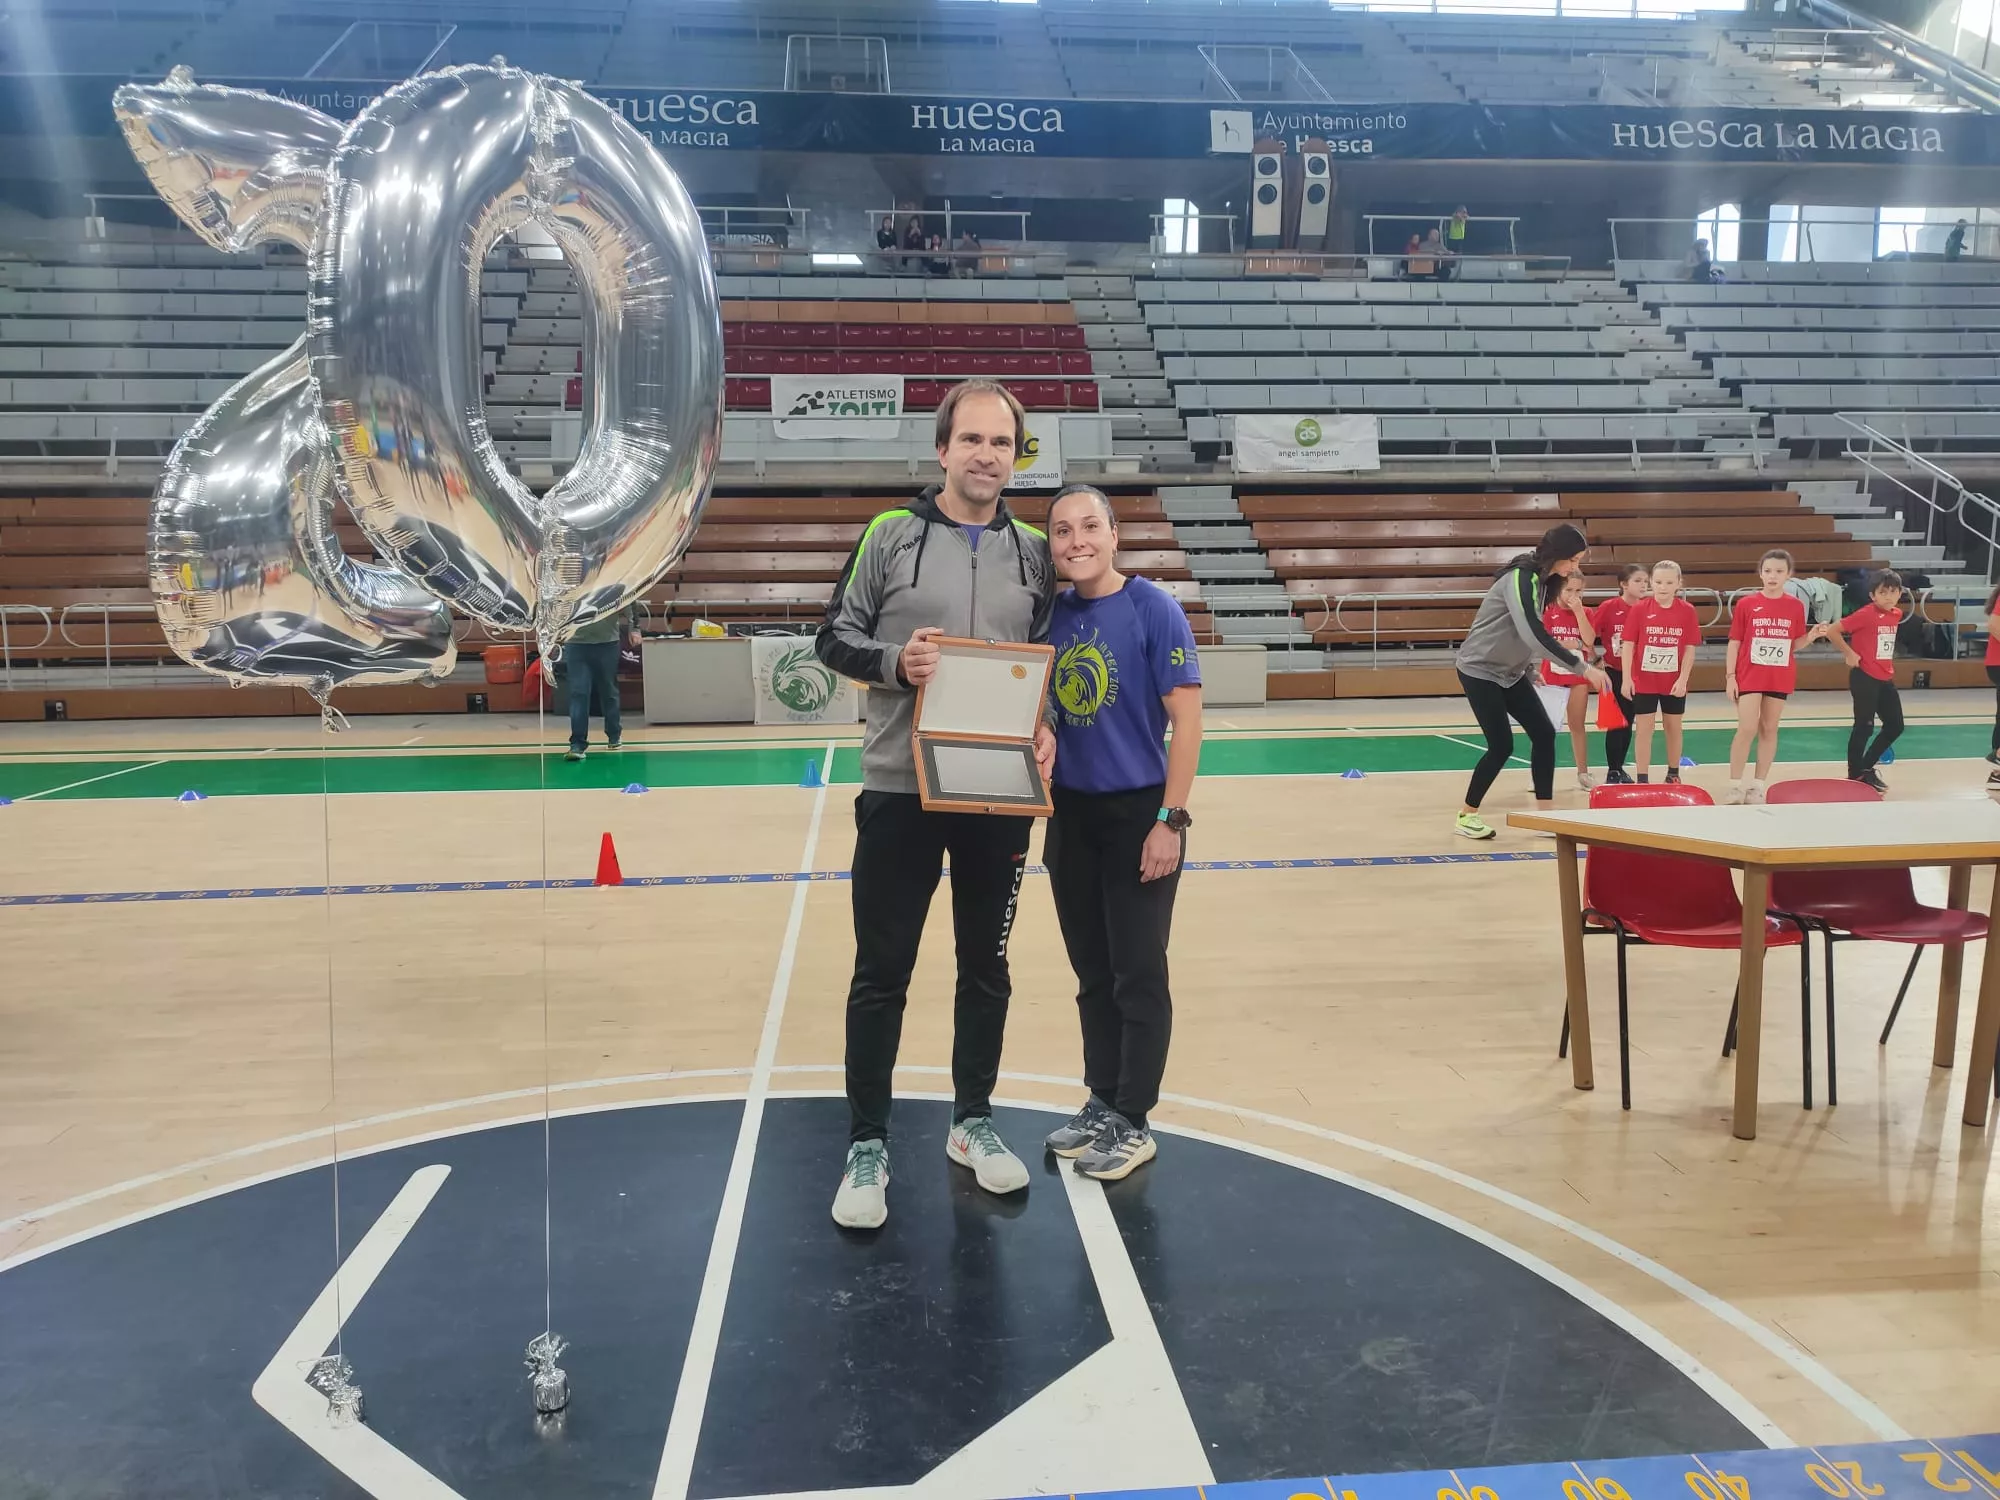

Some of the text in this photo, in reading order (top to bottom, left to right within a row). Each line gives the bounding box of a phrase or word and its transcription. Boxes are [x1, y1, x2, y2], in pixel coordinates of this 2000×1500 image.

[1262, 110, 1407, 133] Ayuntamiento
[1295, 135, 1373, 153] Hesca
[826, 389, 897, 400] ATLETISMO
[1278, 450, 1299, 458] angel
[1759, 645, 1784, 658] 576
[1649, 653, 1674, 665] 577
[1804, 1461, 1886, 1498] 20
